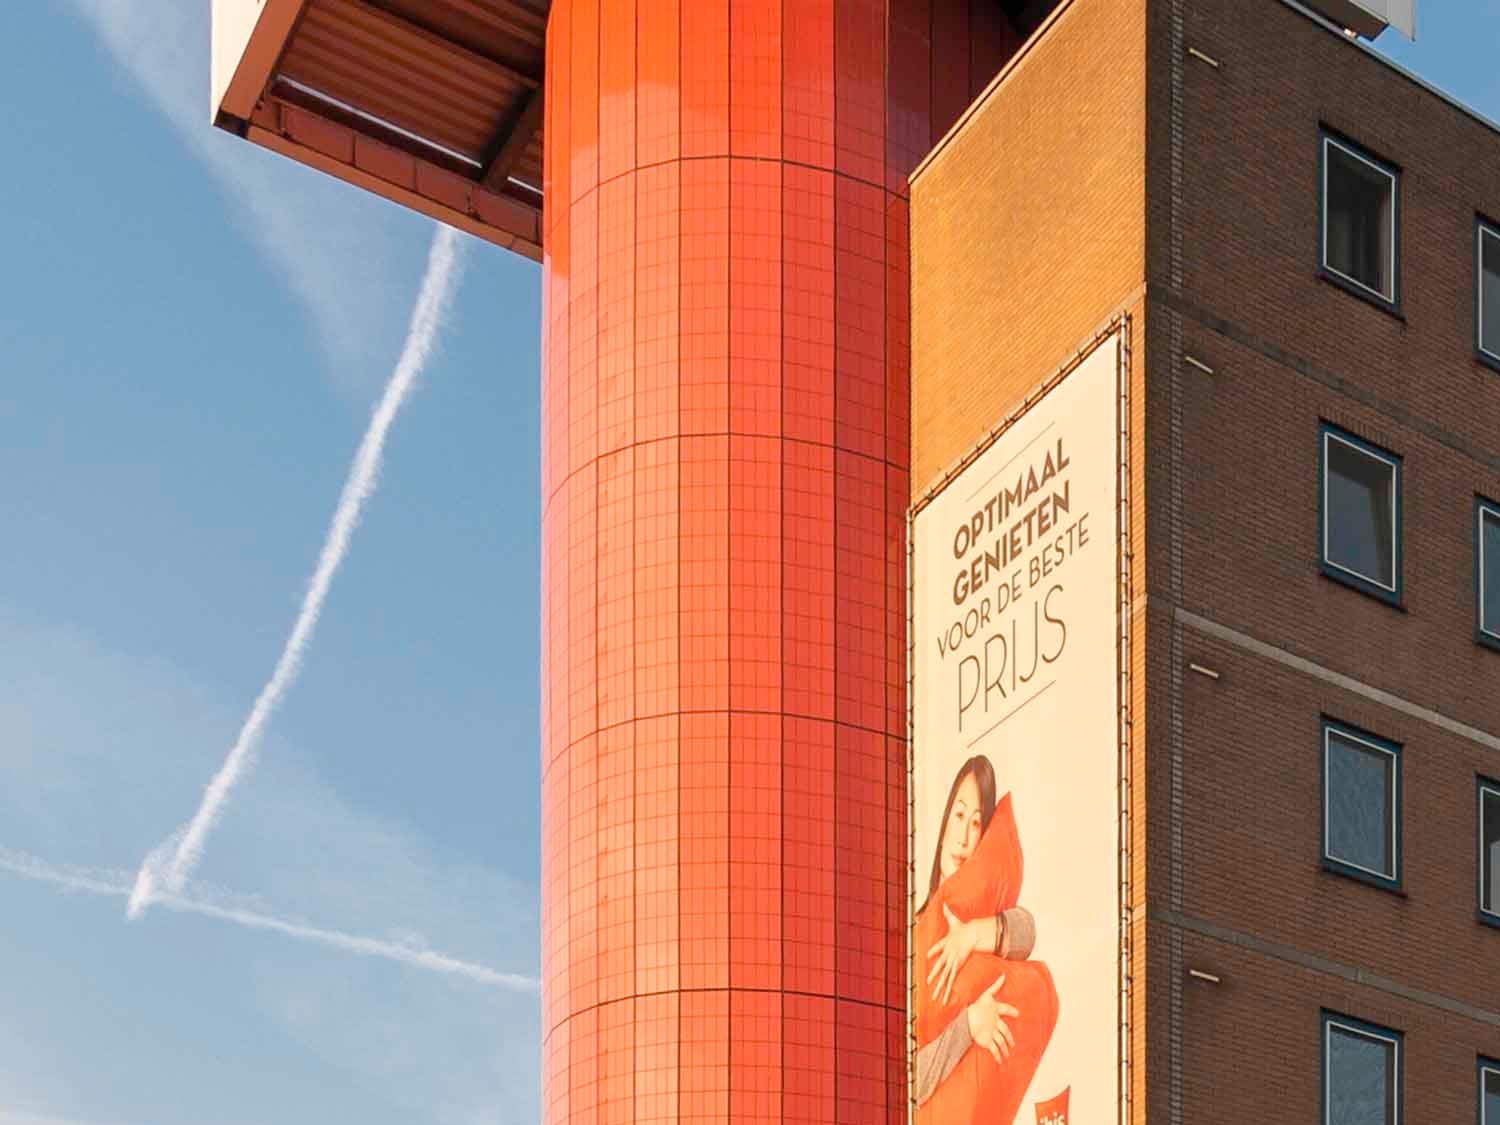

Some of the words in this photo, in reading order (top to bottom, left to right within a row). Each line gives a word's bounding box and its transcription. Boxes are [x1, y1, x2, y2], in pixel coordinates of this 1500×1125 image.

[953, 480, 1070, 605] GENIETEN
[954, 438, 1070, 559] OPTIMAAL
[937, 598, 990, 660] VOOR
[998, 569, 1022, 614] DE
[1029, 512, 1089, 588] BESTE
[959, 585, 1066, 732] PRIJS
